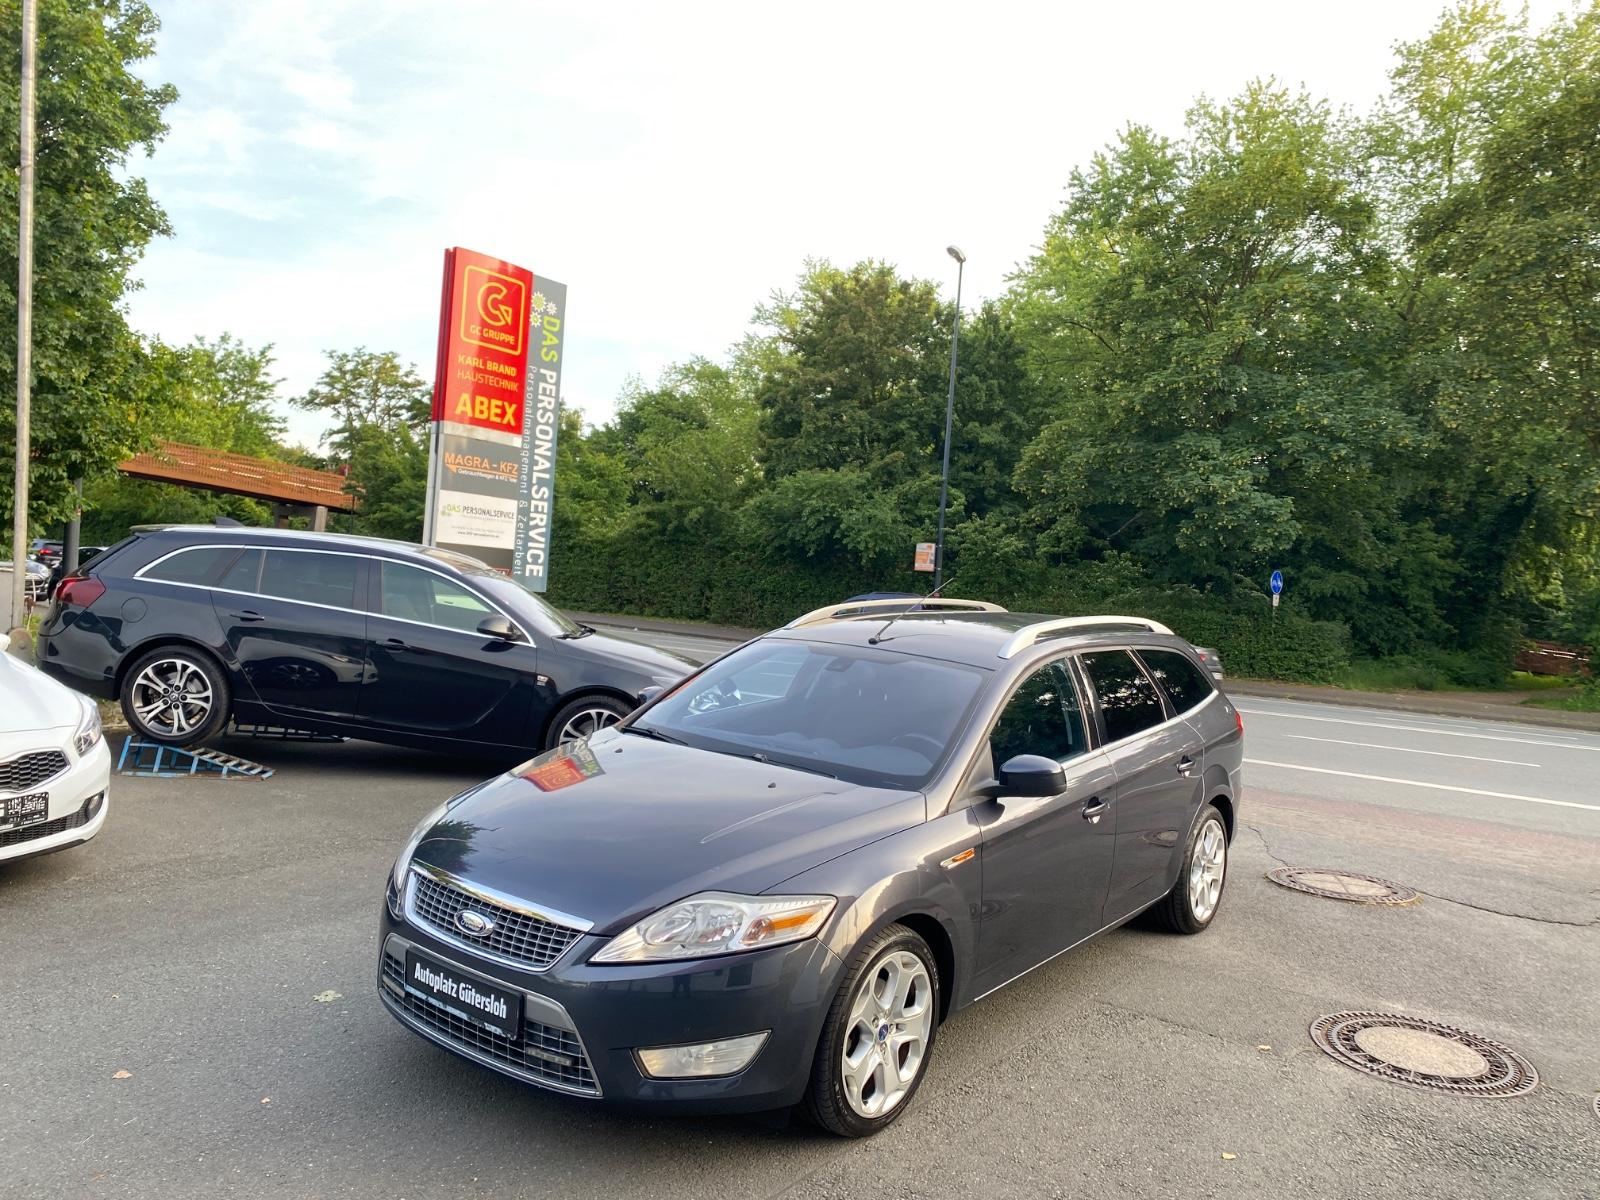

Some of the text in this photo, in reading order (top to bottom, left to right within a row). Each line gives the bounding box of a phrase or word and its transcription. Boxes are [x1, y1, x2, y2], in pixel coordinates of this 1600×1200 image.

[470, 324, 516, 345] GC GRUPPE
[457, 368, 519, 392] HAUSTECHNIK
[458, 354, 516, 377] KARL BRAND
[455, 393, 518, 427] ABEX
[519, 365, 535, 493] Personalmanagement
[525, 315, 561, 577] DAS PERSONALSERVICE
[444, 452, 490, 470] MAGRA
[500, 461, 519, 475] KFZ
[463, 505, 515, 520] PERSONALSERVICE
[513, 515, 527, 575] Zeitarbeit
[414, 962, 457, 998] Autoplatz
[458, 982, 507, 1019] Gütersloh
